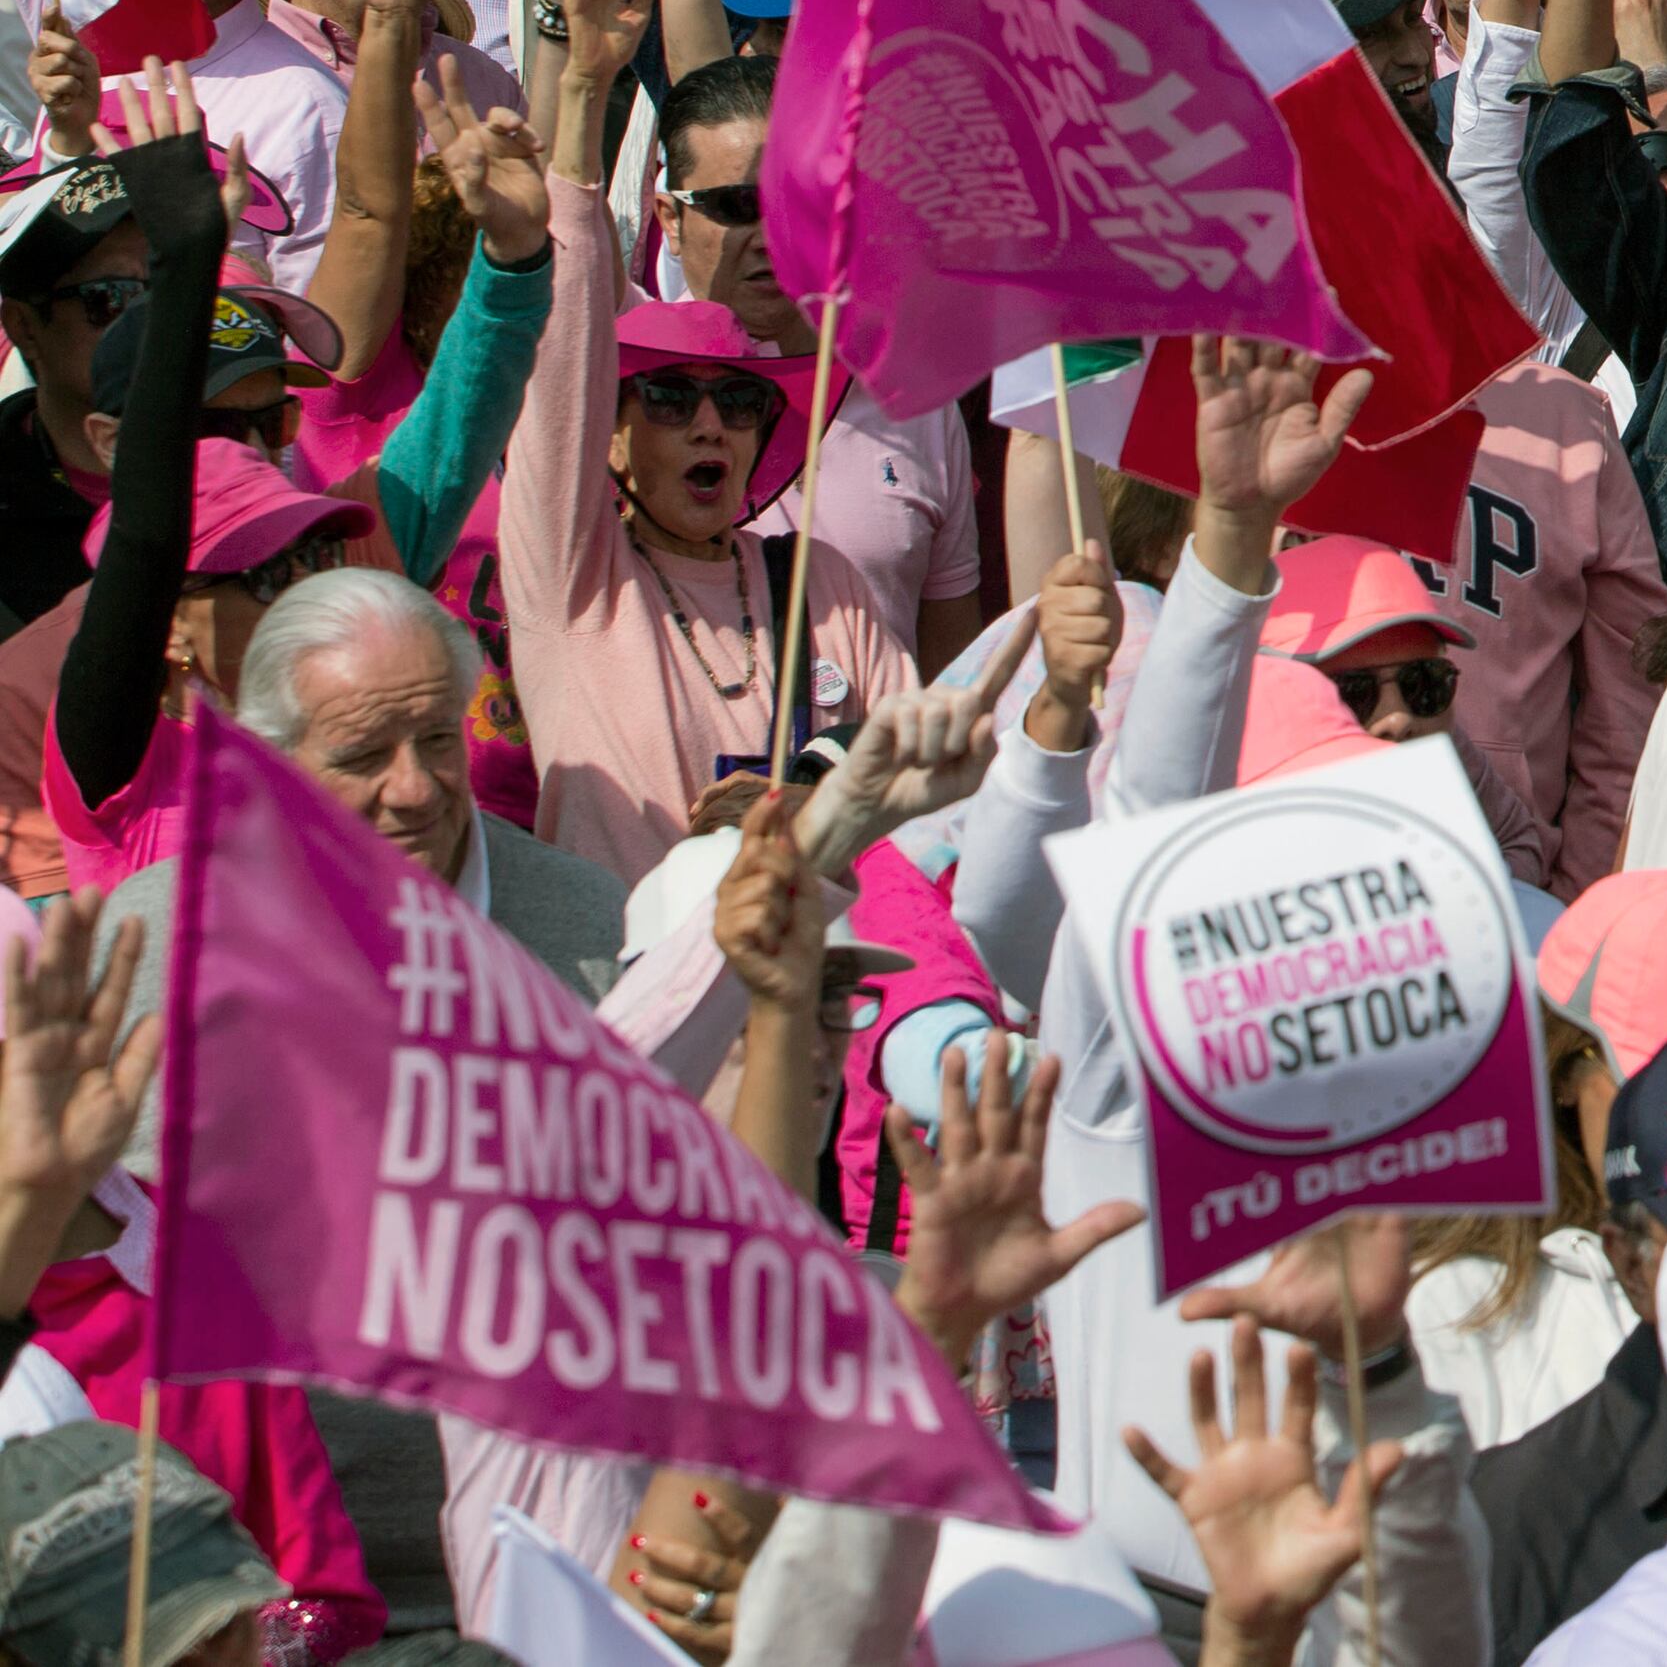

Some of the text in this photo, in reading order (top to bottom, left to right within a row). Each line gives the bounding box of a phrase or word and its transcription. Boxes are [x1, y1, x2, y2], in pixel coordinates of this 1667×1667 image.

[1170, 859, 1434, 970] #NUESTRA
[1181, 917, 1450, 1028] DEMOCRACIA
[1198, 969, 1468, 1097] NOSETOCA
[1190, 1115, 1509, 1242] ¡TÚ DECIDE!
[357, 1192, 943, 1433] NOSETOCA
